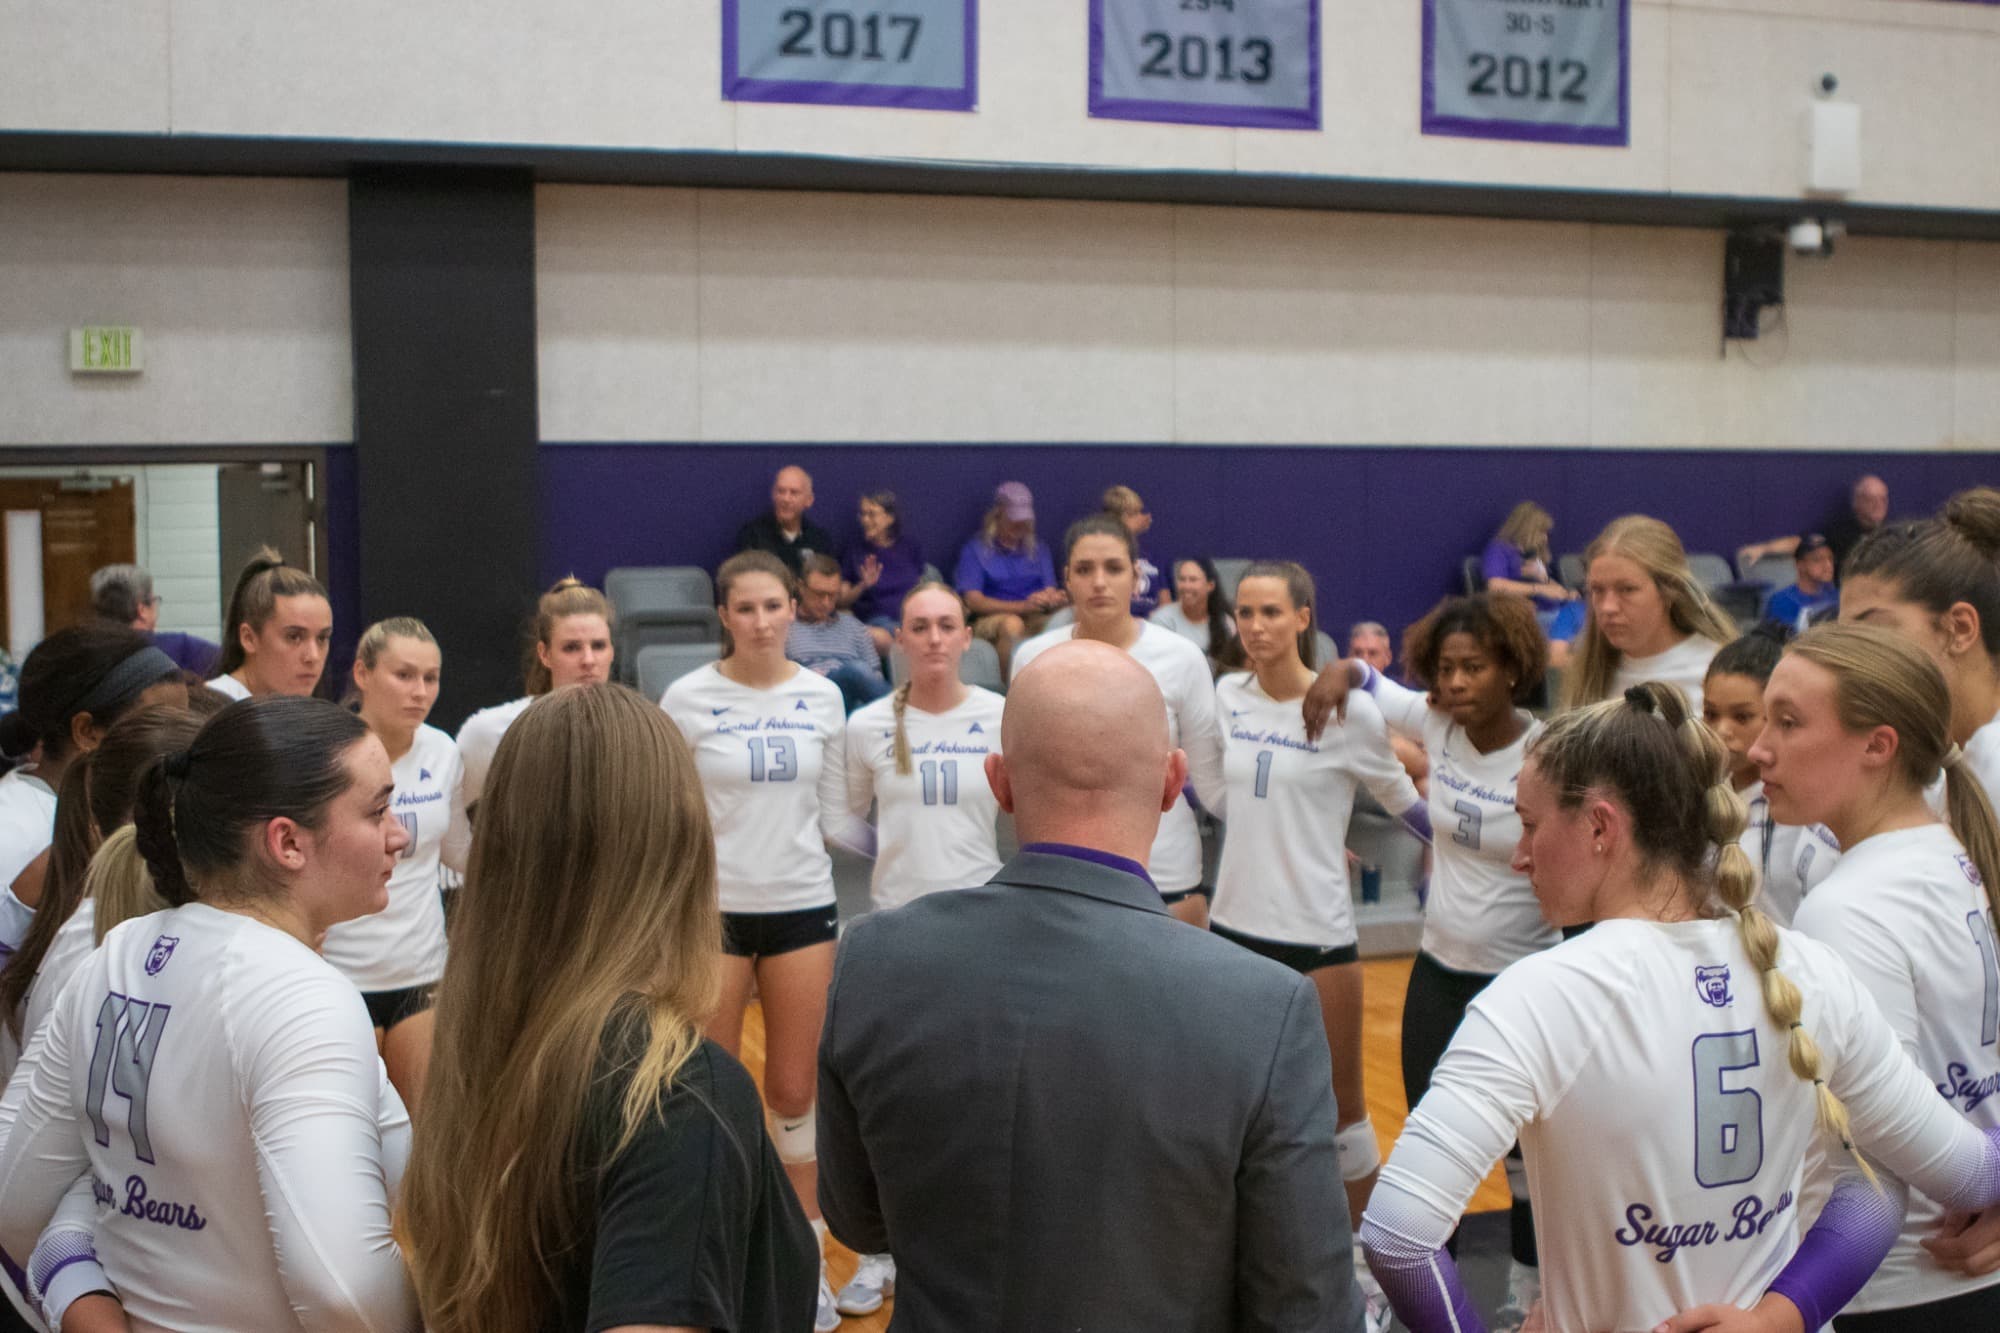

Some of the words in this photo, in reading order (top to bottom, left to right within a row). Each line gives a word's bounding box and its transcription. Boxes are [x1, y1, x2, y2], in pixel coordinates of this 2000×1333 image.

[780, 10, 922, 62] 2017
[1140, 32, 1274, 83] 2013
[1468, 53, 1588, 103] 2012
[83, 328, 135, 368] EXIT
[748, 735, 798, 782] 13
[920, 760, 958, 805] 11
[1254, 750, 1273, 798] 1
[1452, 799, 1482, 850] 3
[86, 991, 171, 1166] 14
[1692, 1028, 1764, 1189] 6
[120, 1174, 207, 1230] Bears
[1615, 1203, 1719, 1264] Sugar
